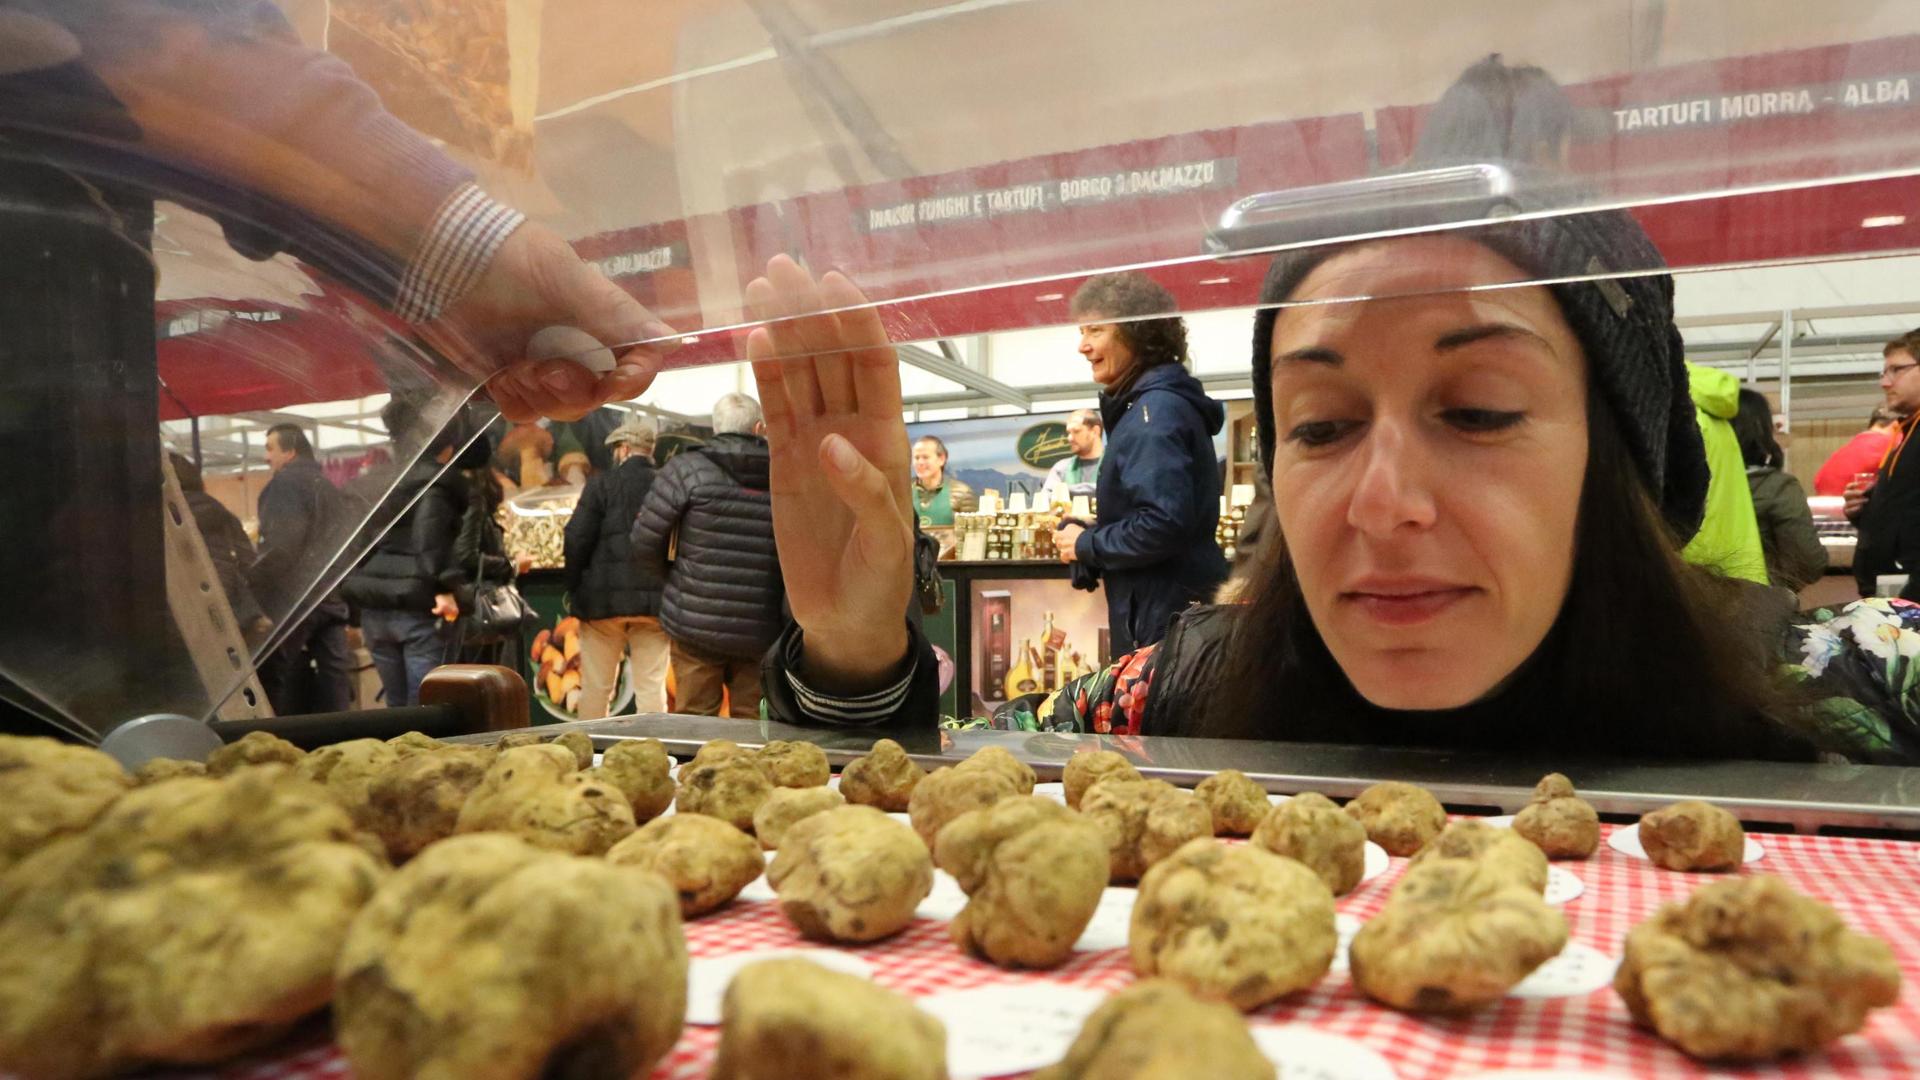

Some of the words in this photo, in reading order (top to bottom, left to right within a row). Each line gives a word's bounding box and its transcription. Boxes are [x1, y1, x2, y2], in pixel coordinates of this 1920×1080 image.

[1613, 100, 1711, 131] TARTUFI
[1720, 90, 1814, 119] MORRA
[1844, 78, 1910, 106] ALBA
[918, 195, 969, 221] FUNGHI
[973, 194, 983, 214] E
[987, 185, 1044, 212] TARTUFI
[1060, 177, 1112, 202] BORGO
[1130, 160, 1214, 193] DALMAZZO
